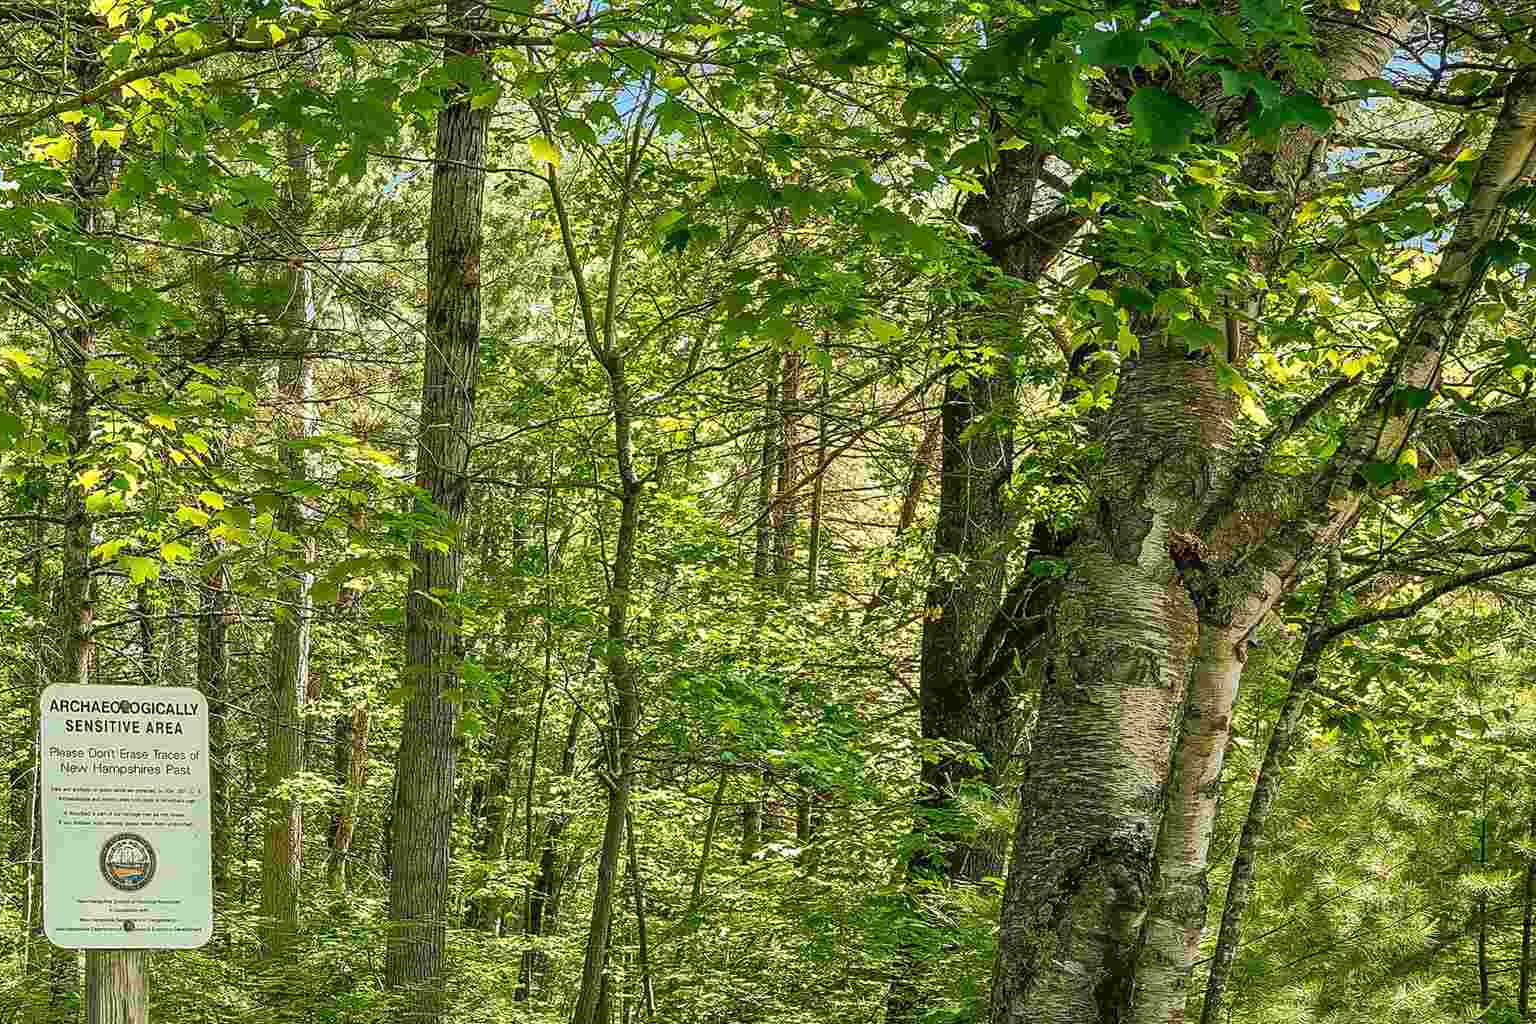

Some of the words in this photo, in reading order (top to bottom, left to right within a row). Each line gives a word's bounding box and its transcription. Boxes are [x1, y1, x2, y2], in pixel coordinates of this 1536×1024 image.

[49, 699, 199, 716] ARCHAEOOGICALLY
[65, 719, 140, 734] SENSITIVE
[146, 721, 183, 735] AREA
[49, 747, 85, 759] Please
[119, 748, 149, 760] Erase
[152, 749, 186, 761] Traces
[190, 749, 200, 761] of
[60, 761, 89, 774] New
